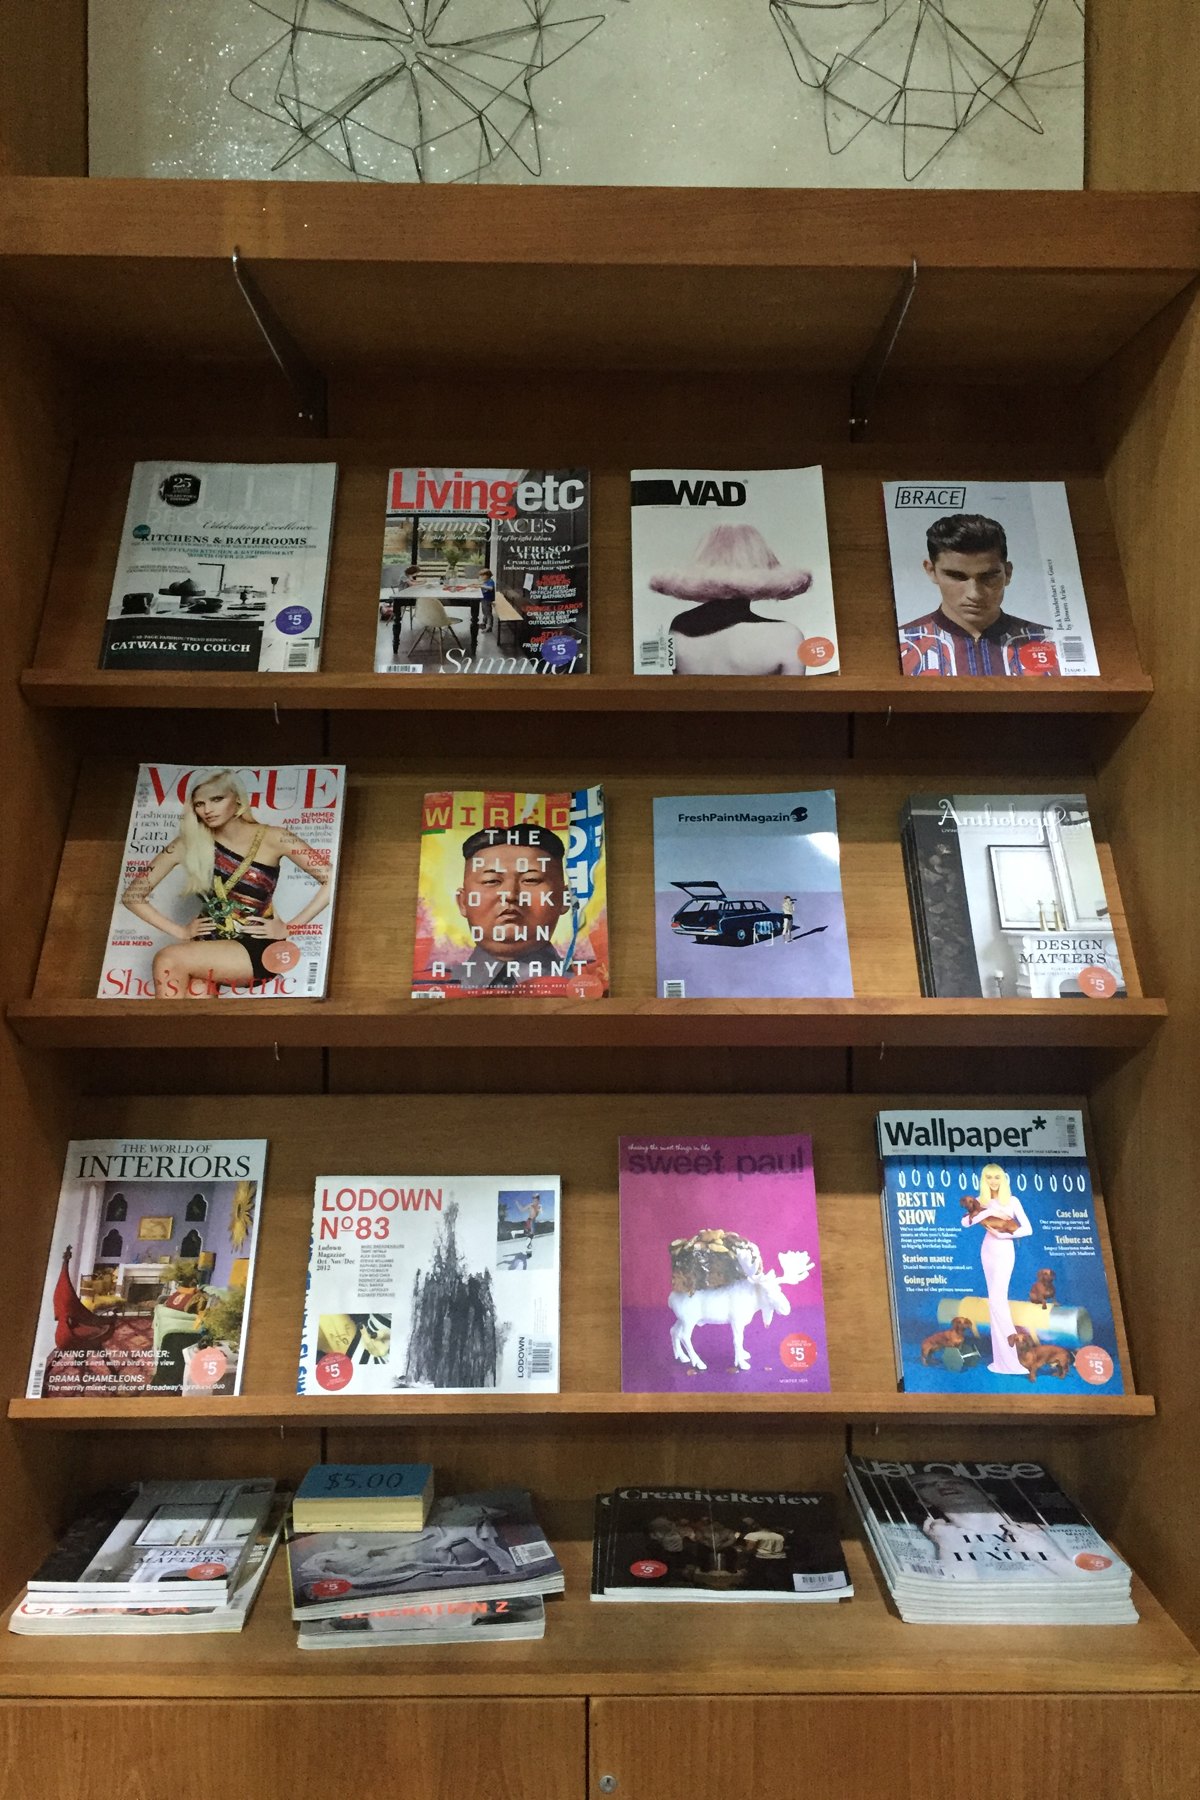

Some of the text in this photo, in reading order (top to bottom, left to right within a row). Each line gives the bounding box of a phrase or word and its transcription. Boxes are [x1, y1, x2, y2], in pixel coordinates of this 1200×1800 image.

[173, 477, 192, 488] 25
[671, 480, 747, 507] WAD
[900, 490, 961, 505] BRACE
[141, 534, 208, 544] KITCHENS
[226, 537, 307, 545] BATHROOMS
[288, 614, 301, 625] $5
[111, 641, 250, 652] CATWALK TO COUCH
[552, 644, 566, 655] $5
[811, 646, 826, 657] $5
[1032, 652, 1048, 663] $5
[937, 798, 1067, 842] Anthology
[132, 827, 168, 841] Lara
[484, 830, 541, 845] THE
[128, 841, 175, 854] Stone
[472, 857, 551, 874] PLOT
[497, 891, 572, 907] TAKE
[471, 925, 550, 941] DOWN
[1037, 939, 1104, 951] DESIGN
[276, 952, 290, 964] $5
[1019, 953, 1107, 964] MATTERS
[432, 960, 587, 978] A TYRANT
[102, 968, 180, 997] She's
[1090, 978, 1105, 991] $5
[121, 1143, 213, 1154] THE WORLD OF
[76, 1155, 250, 1179] INTERIORS
[628, 1147, 804, 1182] sweet paul
[321, 1188, 442, 1212] LODOWN
[896, 1191, 945, 1207] BEST IN
[899, 1209, 936, 1224] SHOW
[1055, 1208, 1088, 1218] Case load
[1055, 1235, 1093, 1244] Tribute act
[902, 1253, 954, 1263] Station master
[904, 1274, 948, 1286] Going public
[54, 1350, 170, 1358] TAKING FLIGHT IN TANGIER:
[517, 1336, 525, 1378] LODOWN
[790, 1347, 805, 1361] $5
[203, 1362, 217, 1375] $5
[325, 1363, 341, 1378] $5
[1089, 1360, 1104, 1375] $5
[49, 1374, 145, 1383] DRAMA CHAMELEONS:
[324, 1471, 404, 1491] $5.00
[160, 1549, 227, 1557] DESIGN
[324, 1582, 338, 1591] $5
[495, 1601, 509, 1612] Z
